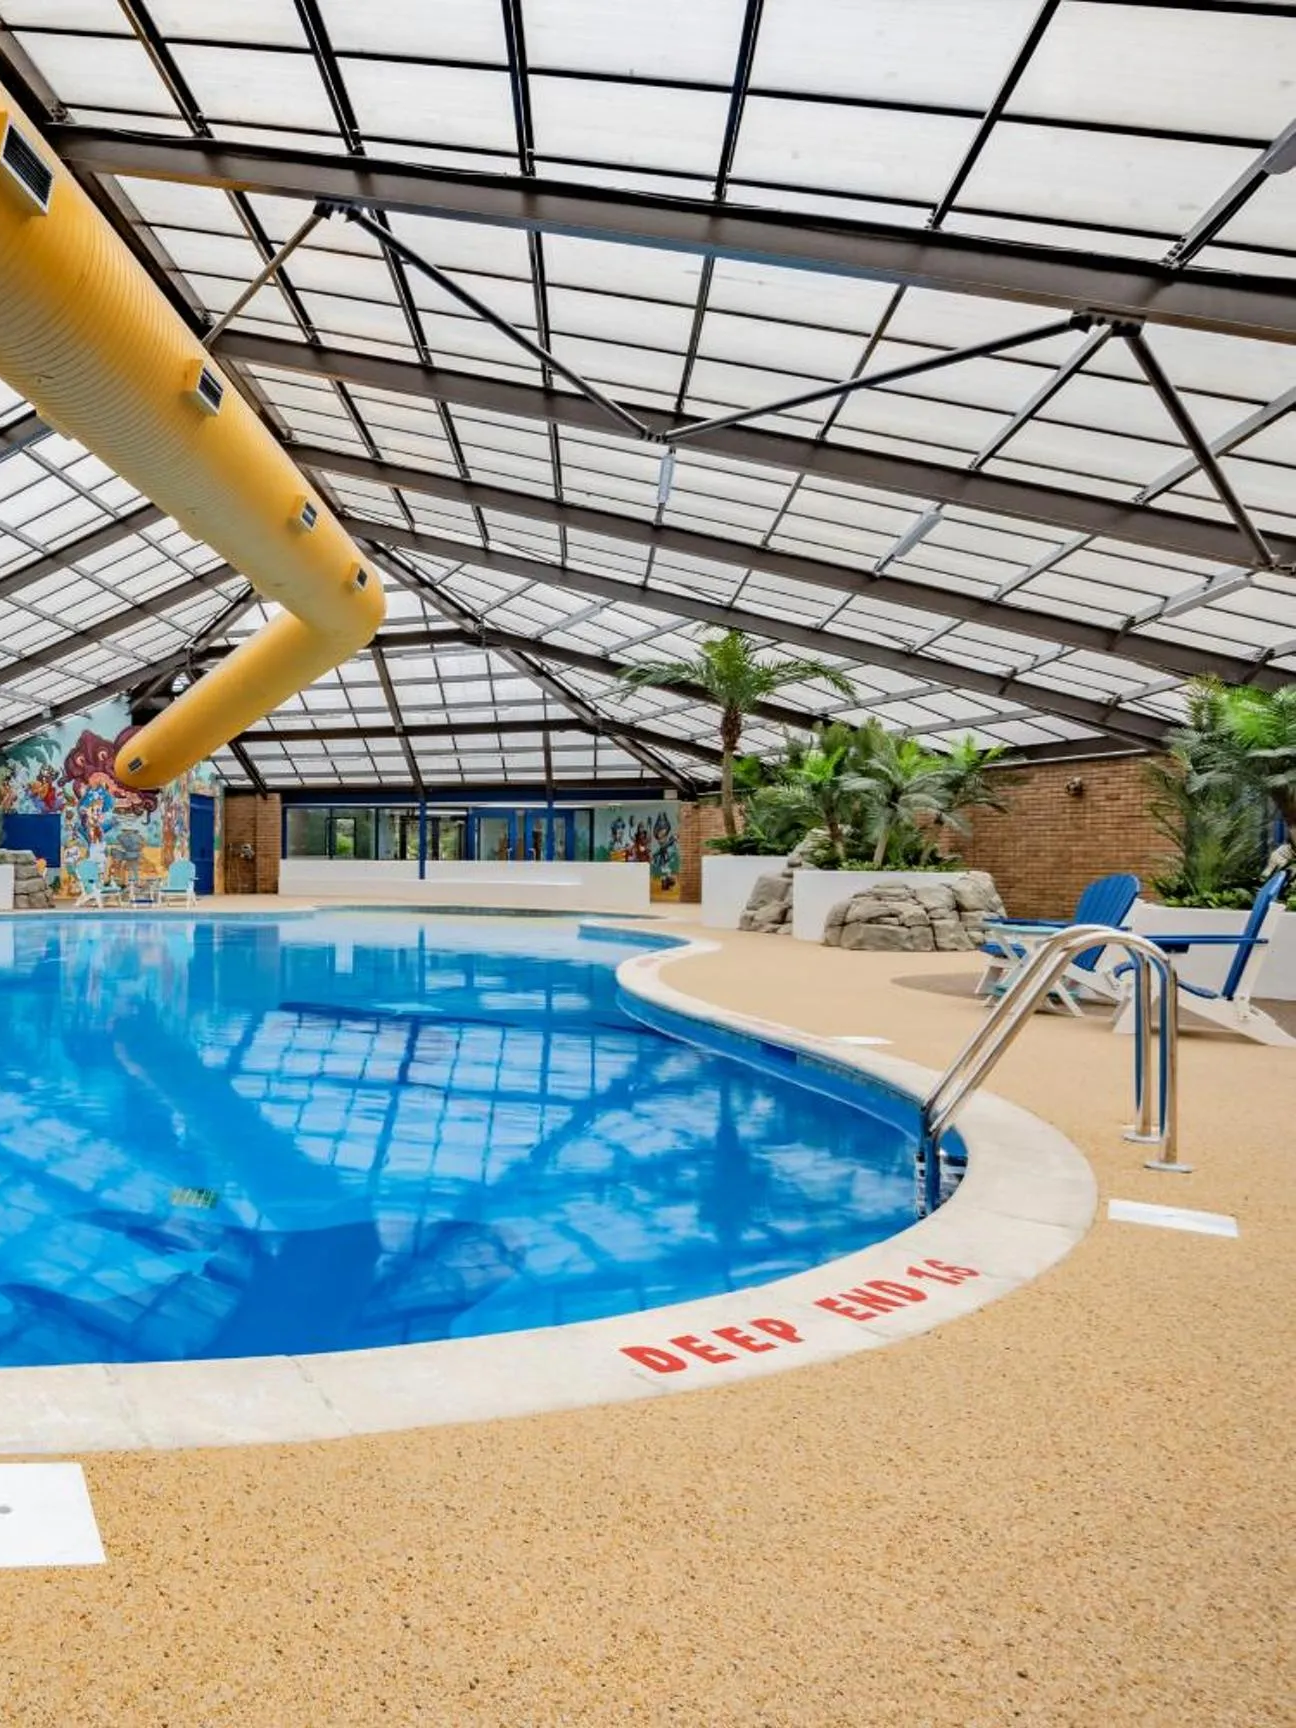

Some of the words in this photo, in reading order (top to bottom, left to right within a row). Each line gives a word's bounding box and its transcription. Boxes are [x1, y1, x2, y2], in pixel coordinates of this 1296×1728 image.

[619, 1317, 805, 1374] DEEP
[814, 1280, 928, 1321] END
[906, 1258, 980, 1286] 1.6
